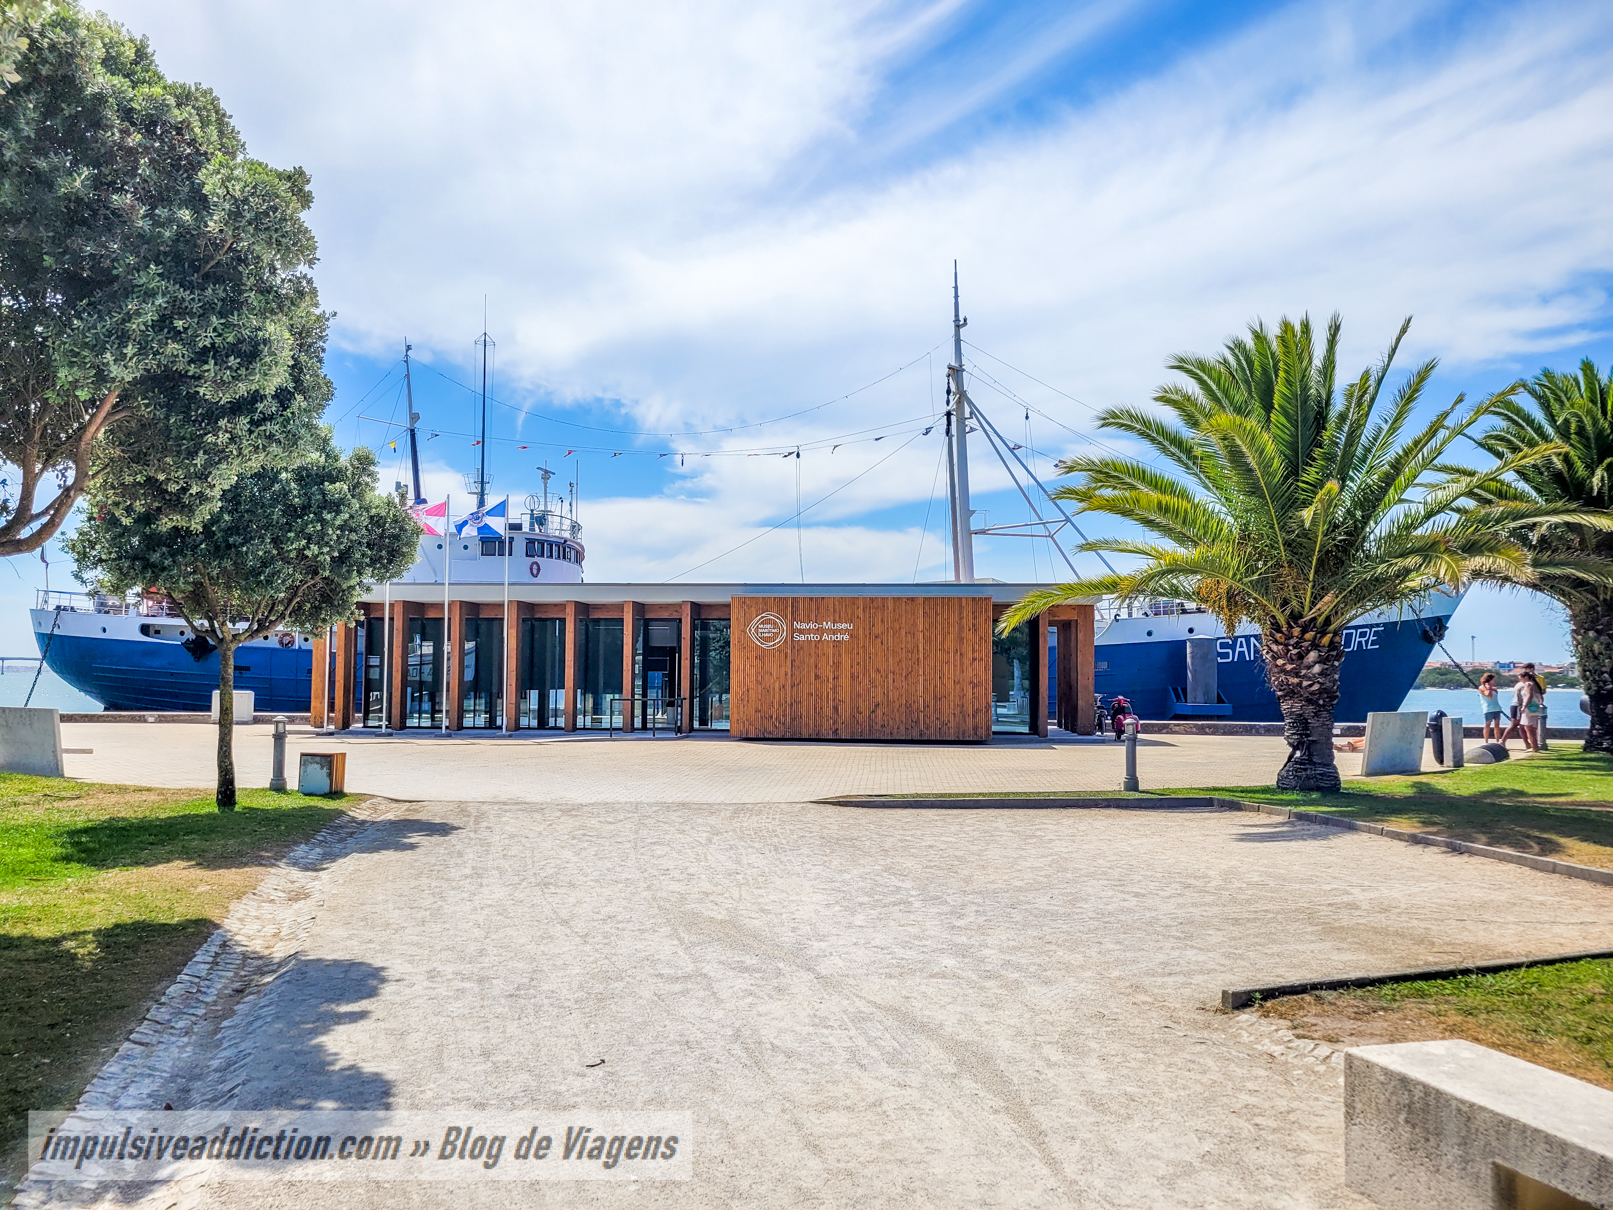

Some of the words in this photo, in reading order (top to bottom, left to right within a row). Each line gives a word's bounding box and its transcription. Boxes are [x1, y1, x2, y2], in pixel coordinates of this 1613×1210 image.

[793, 621, 853, 629] Navio-Museu
[793, 632, 820, 641] Santo
[821, 632, 850, 641] André
[1216, 636, 1266, 663] SAN
[1340, 623, 1385, 652] DRÉ
